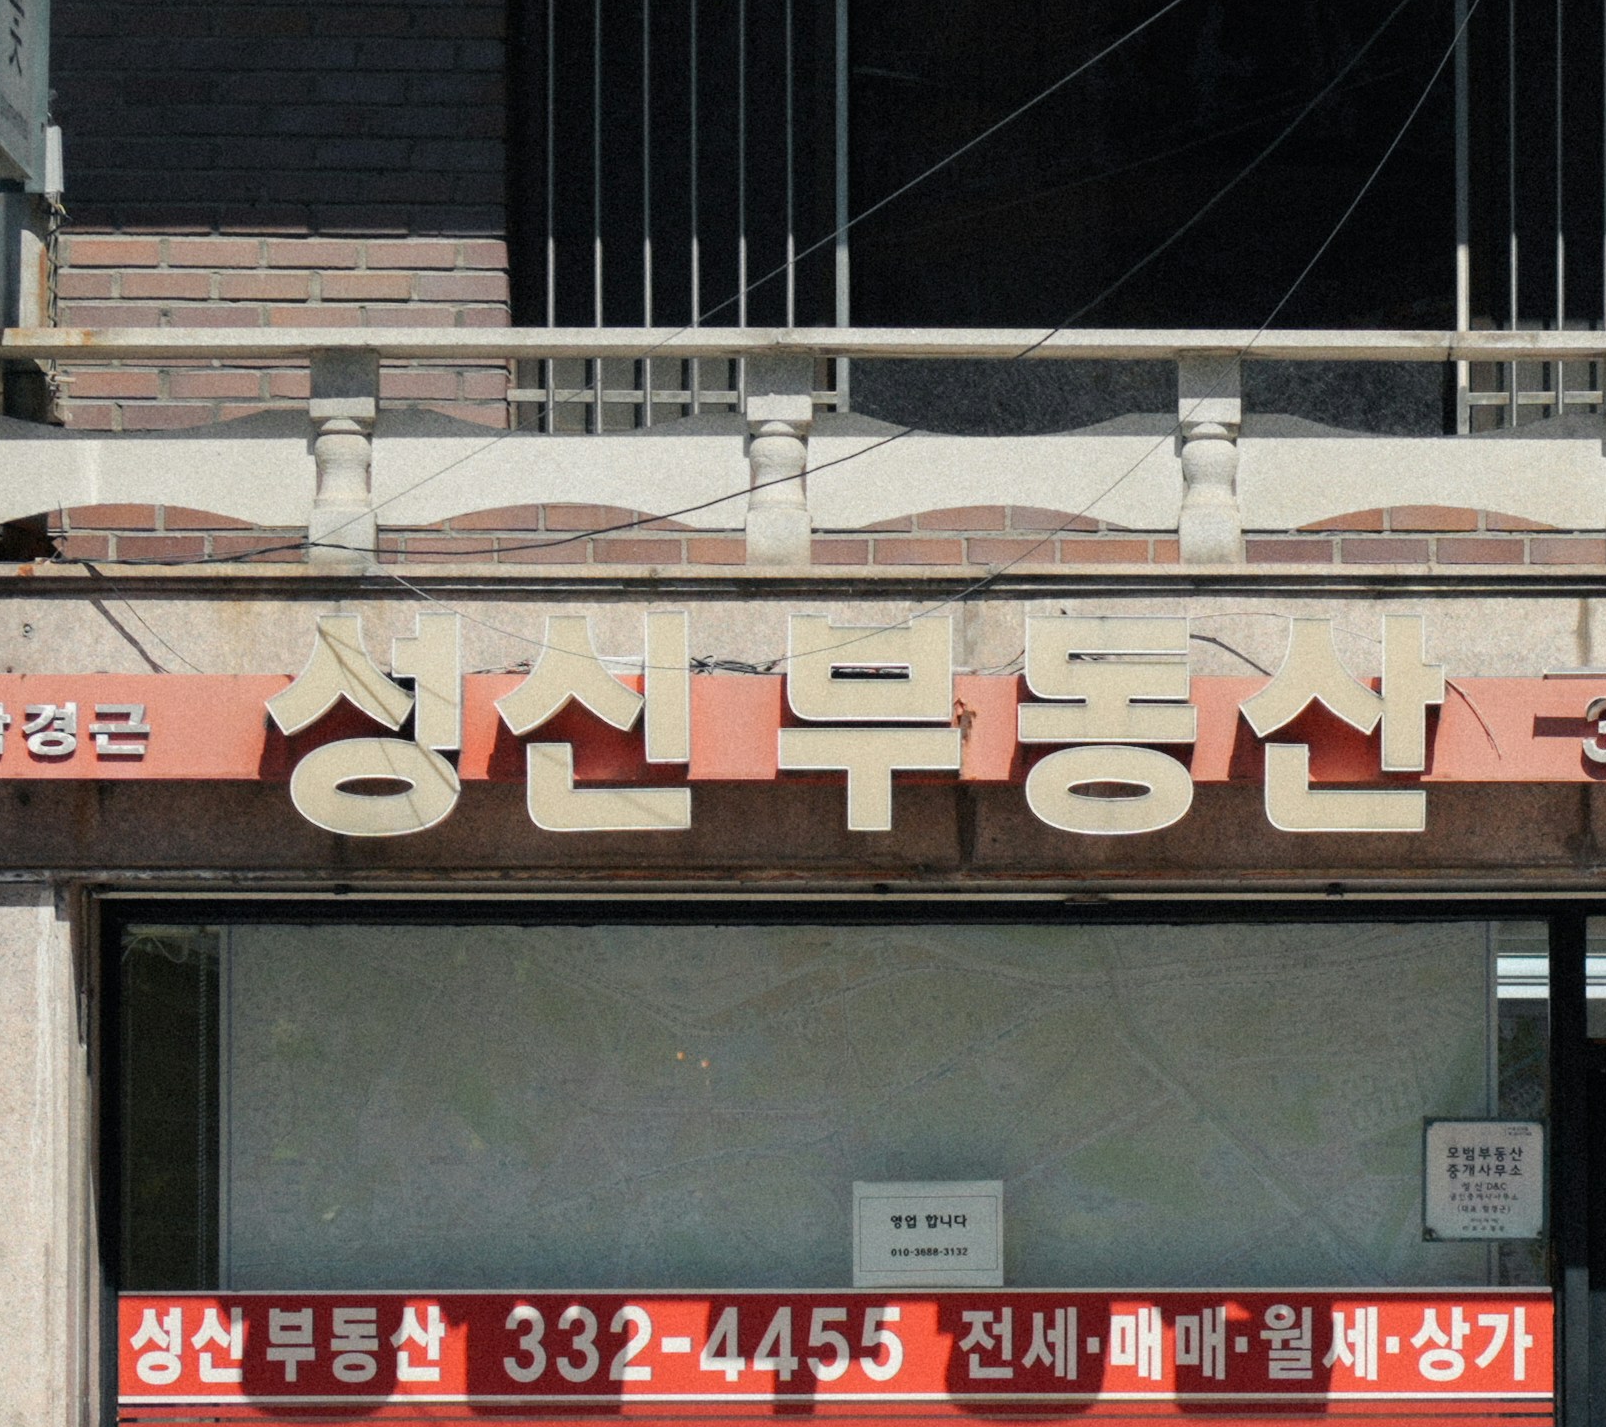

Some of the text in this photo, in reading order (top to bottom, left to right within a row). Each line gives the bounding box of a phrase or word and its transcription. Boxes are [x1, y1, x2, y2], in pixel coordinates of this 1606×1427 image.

[265, 611, 1448, 838] 성신부동산
[1447, 1147, 1523, 1162] 모범부동산
[1447, 1164, 1523, 1179] 중개사무소
[890, 1215, 967, 1229] 영업 합니다
[130, 1304, 1535, 1384] 성신부동산 332-4455 전세·매매·월세·상가
